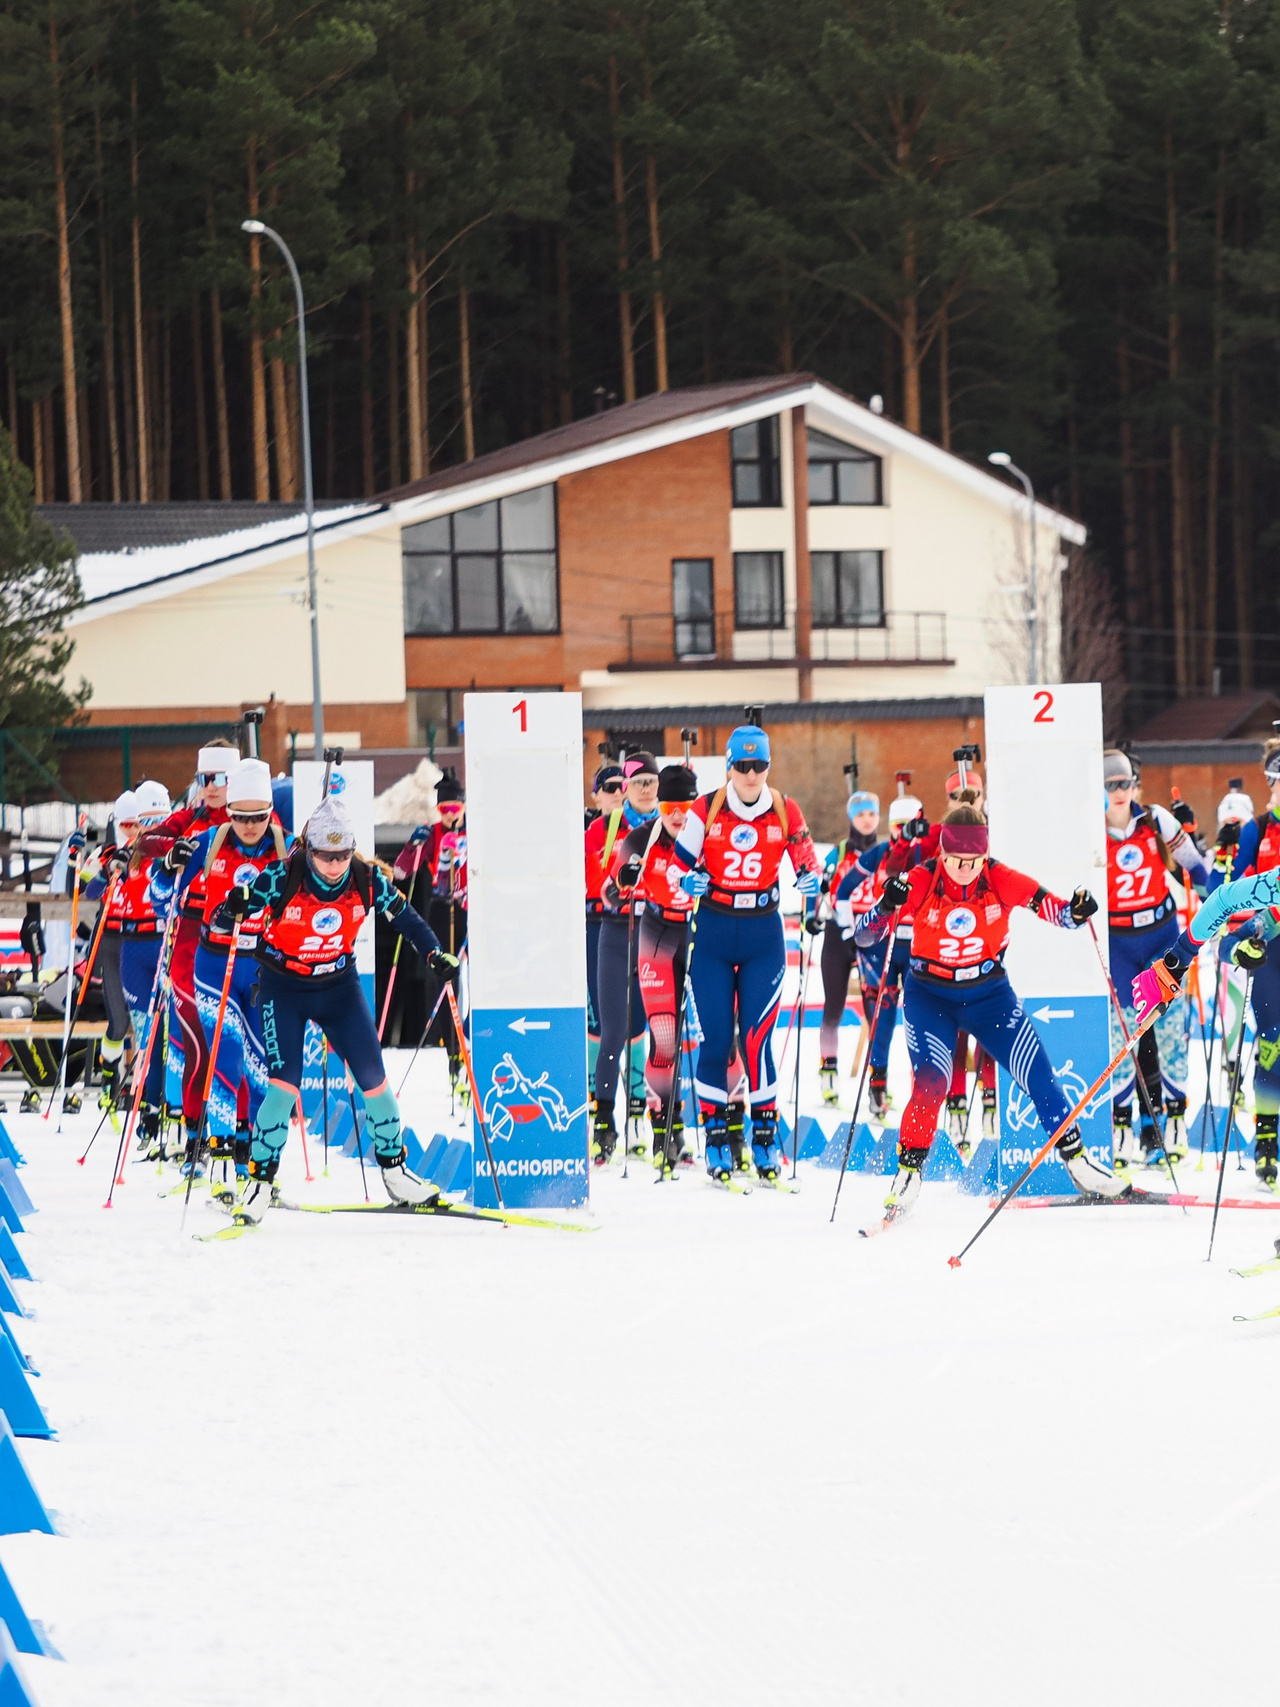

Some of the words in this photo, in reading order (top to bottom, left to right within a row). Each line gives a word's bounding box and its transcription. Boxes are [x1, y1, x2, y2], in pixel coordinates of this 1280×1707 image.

[511, 700, 529, 732] 1
[1033, 690, 1055, 722] 2
[723, 851, 763, 879] 26
[1115, 867, 1153, 899] 27
[297, 934, 345, 952] 21
[938, 936, 985, 958] 22
[475, 1158, 586, 1178] КРАСНОЯРСК
